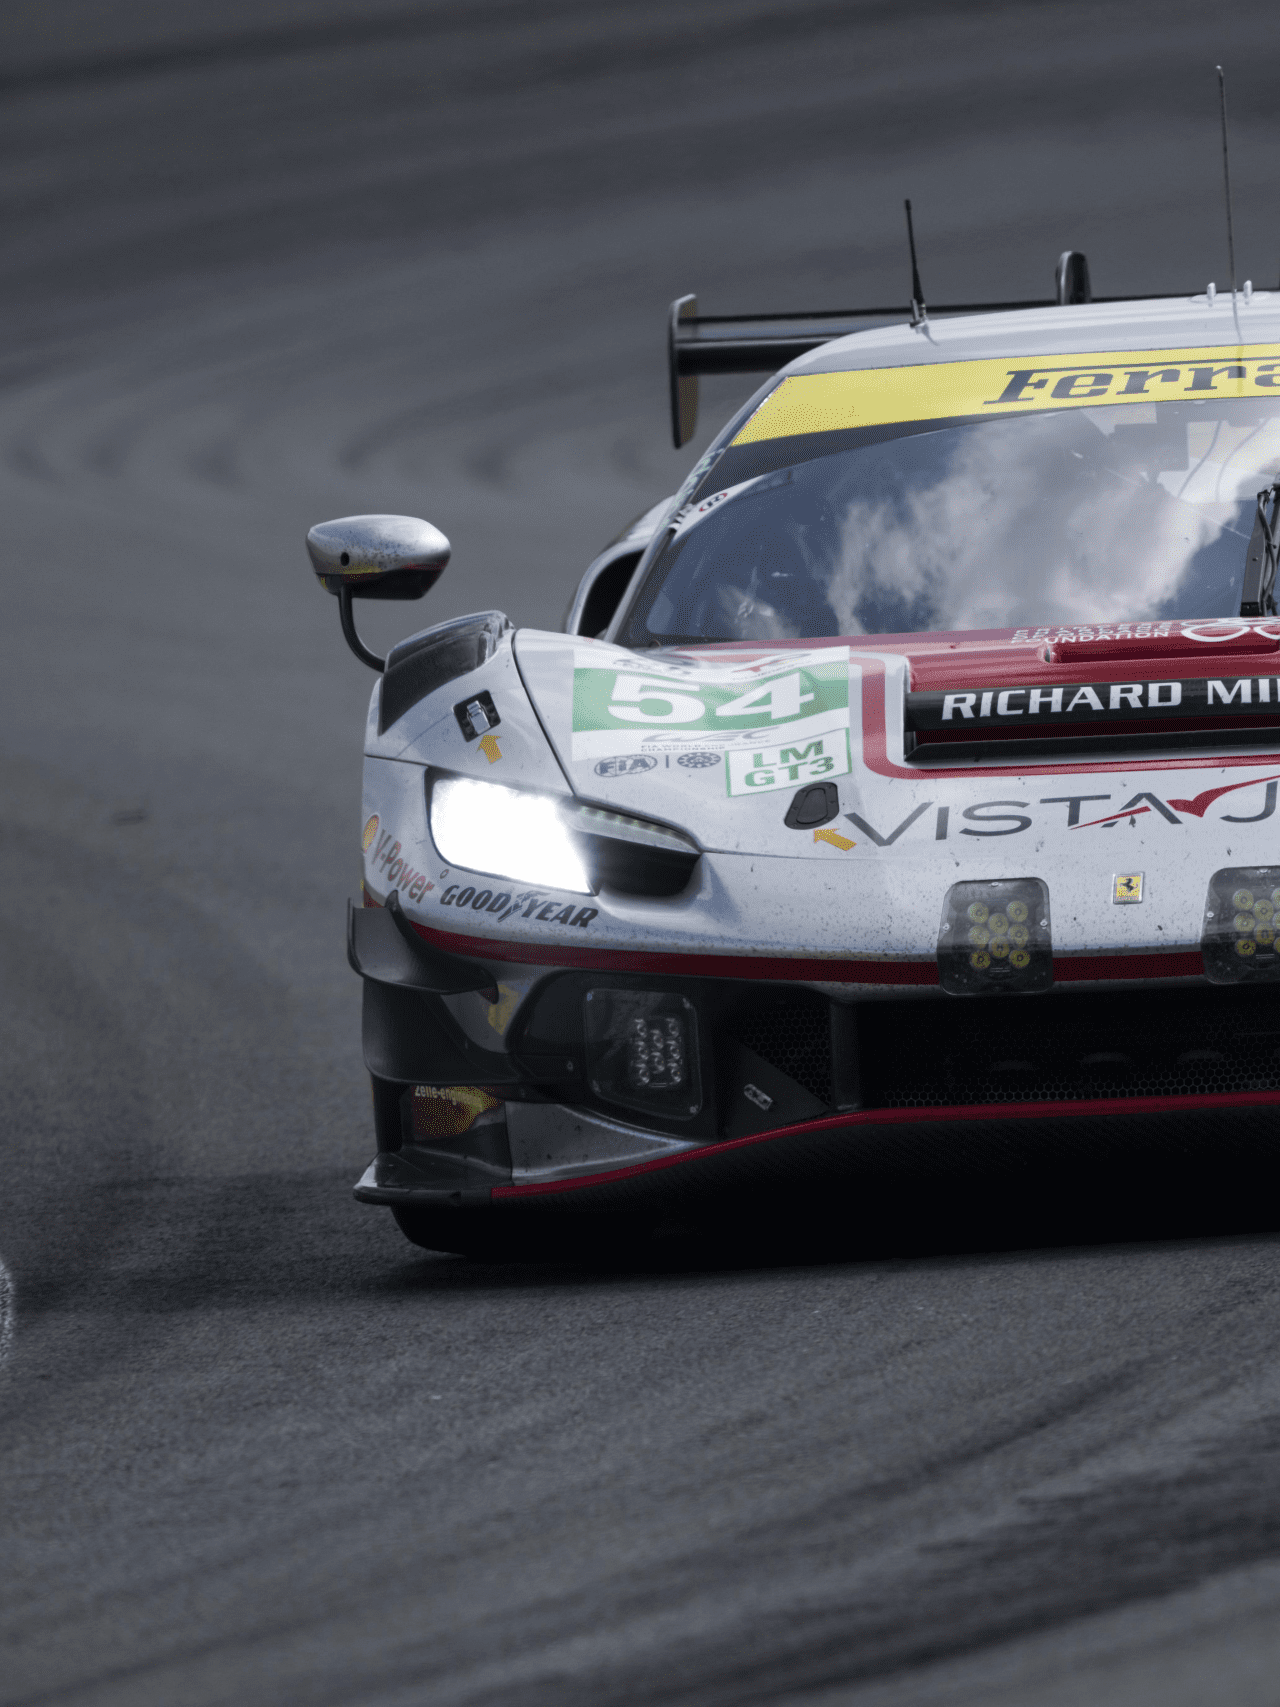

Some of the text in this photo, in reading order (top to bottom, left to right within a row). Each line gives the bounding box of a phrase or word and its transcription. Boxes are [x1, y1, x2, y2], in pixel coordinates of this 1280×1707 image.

[608, 672, 815, 724] 54
[941, 681, 1182, 720] RICHARD
[744, 756, 835, 787] GT3
[752, 740, 824, 769] LM
[371, 828, 435, 904] V-Power
